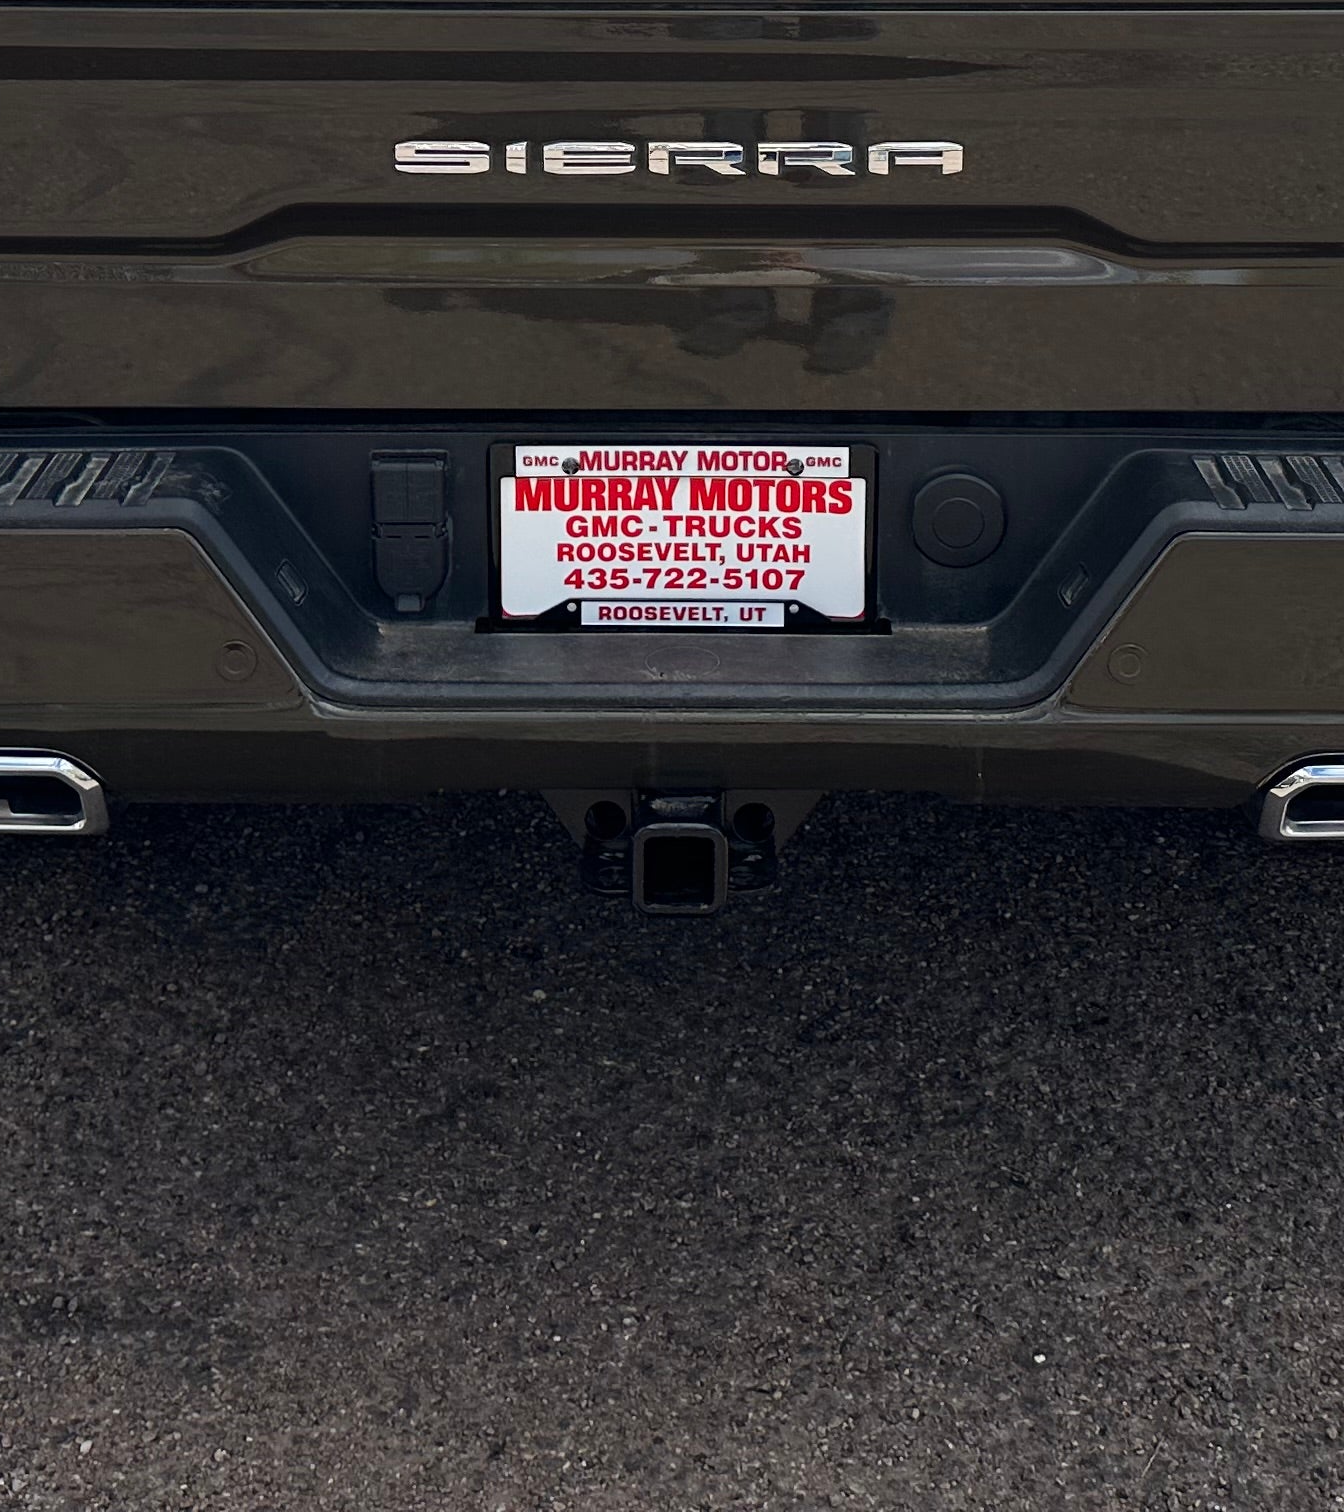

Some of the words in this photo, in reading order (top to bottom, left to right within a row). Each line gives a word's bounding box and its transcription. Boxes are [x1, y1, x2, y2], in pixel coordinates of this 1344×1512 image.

[393, 138, 964, 177] SIERRA
[522, 455, 560, 467] GMC
[578, 450, 689, 471] MURRAY
[697, 450, 788, 472] MOTOR
[805, 456, 843, 468] GMC
[515, 476, 681, 512] MURRAY
[690, 478, 853, 515] MOTORS
[556, 542, 726, 566] ROOSEVELT,
[736, 543, 811, 563] UTAH
[563, 567, 806, 590] 435-722-5107
[597, 605, 729, 623] ROOSEVELT,
[739, 607, 767, 622] UT
